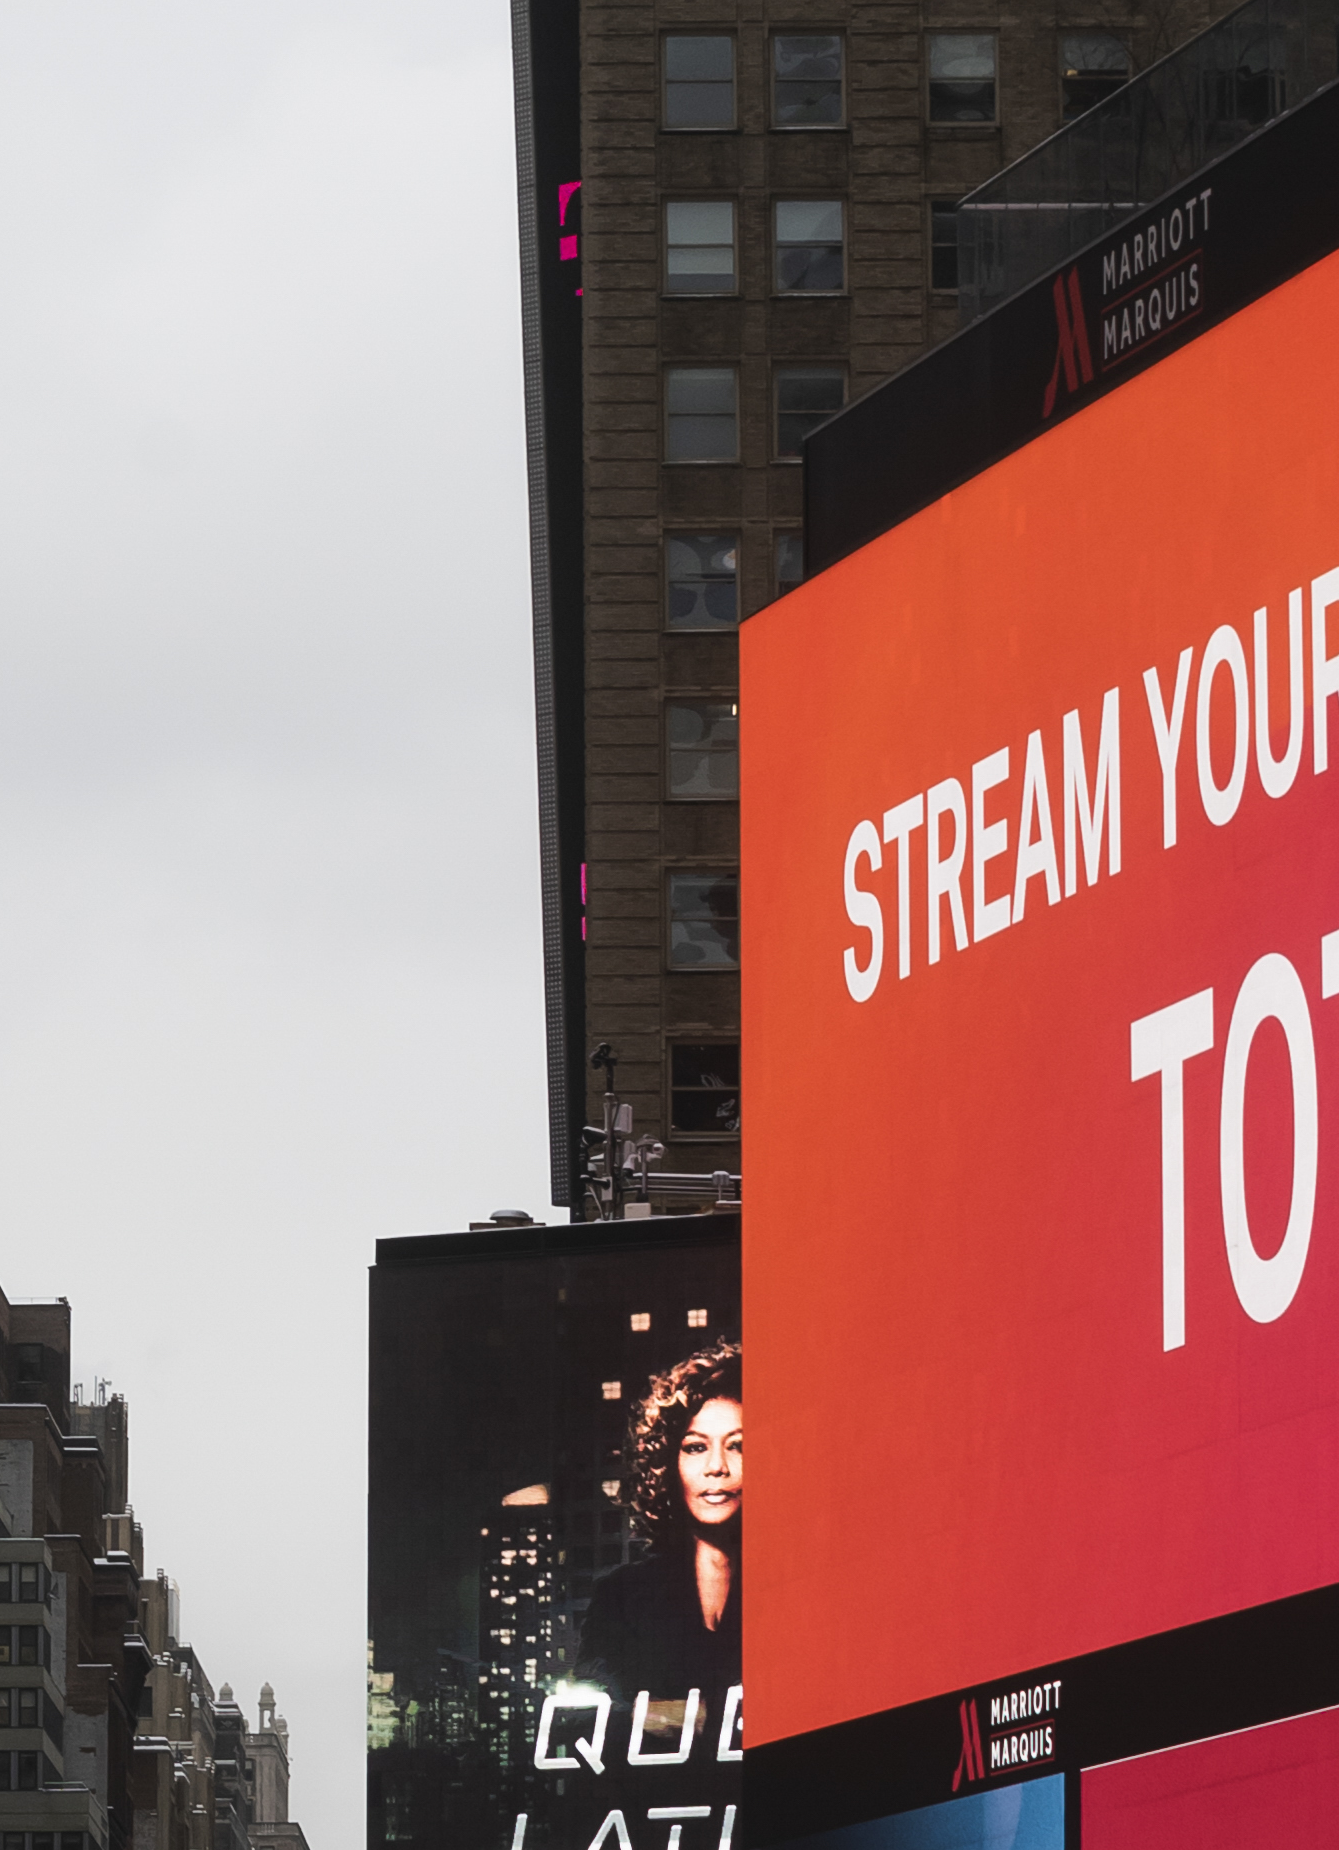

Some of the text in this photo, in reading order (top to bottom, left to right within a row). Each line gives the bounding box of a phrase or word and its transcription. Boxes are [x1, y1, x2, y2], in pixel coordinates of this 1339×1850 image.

[1103, 187, 1212, 296] MARRIOTT
[1104, 263, 1200, 360] MARQUIS
[843, 687, 1121, 1004] STREAM
[990, 1680, 1062, 1727] MARRIOTT
[990, 1725, 1054, 1769] MARQUIS
